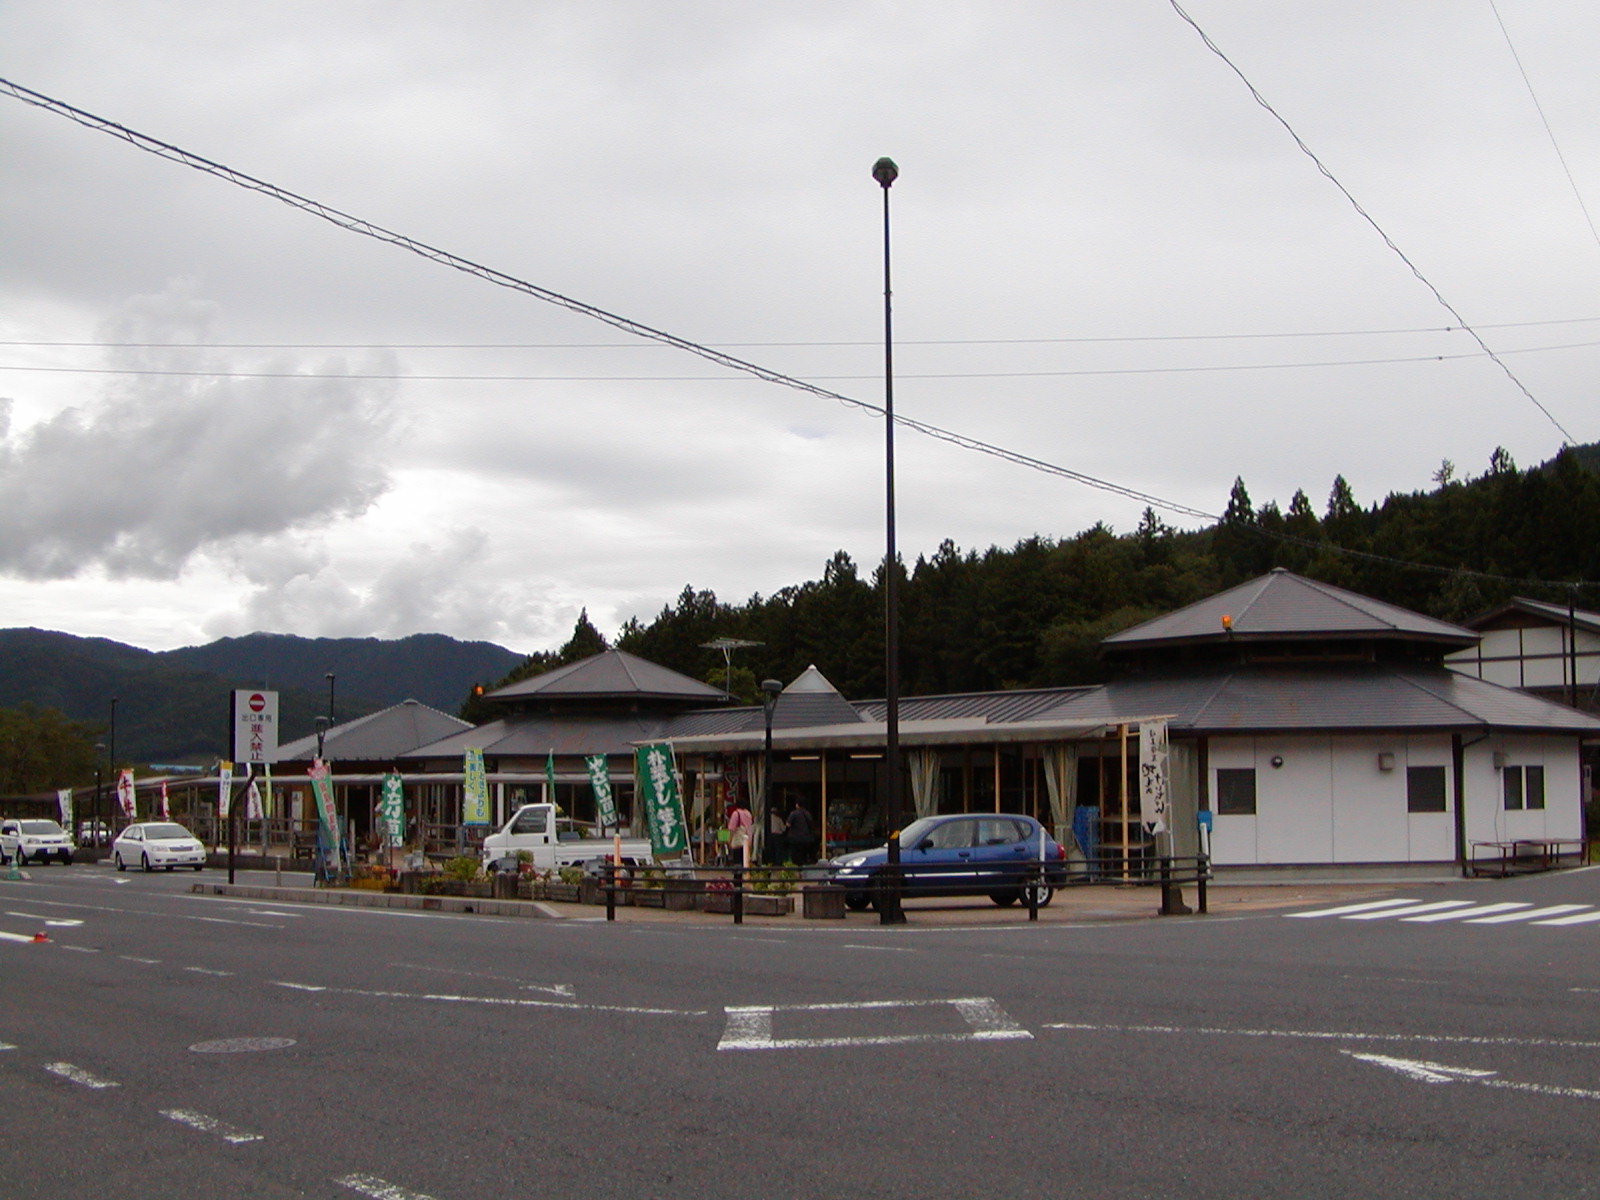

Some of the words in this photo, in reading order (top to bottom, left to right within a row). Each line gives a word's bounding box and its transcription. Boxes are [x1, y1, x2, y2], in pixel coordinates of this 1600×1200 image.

[241, 713, 272, 723] 出口専用
[250, 723, 264, 761] 進入禁止
